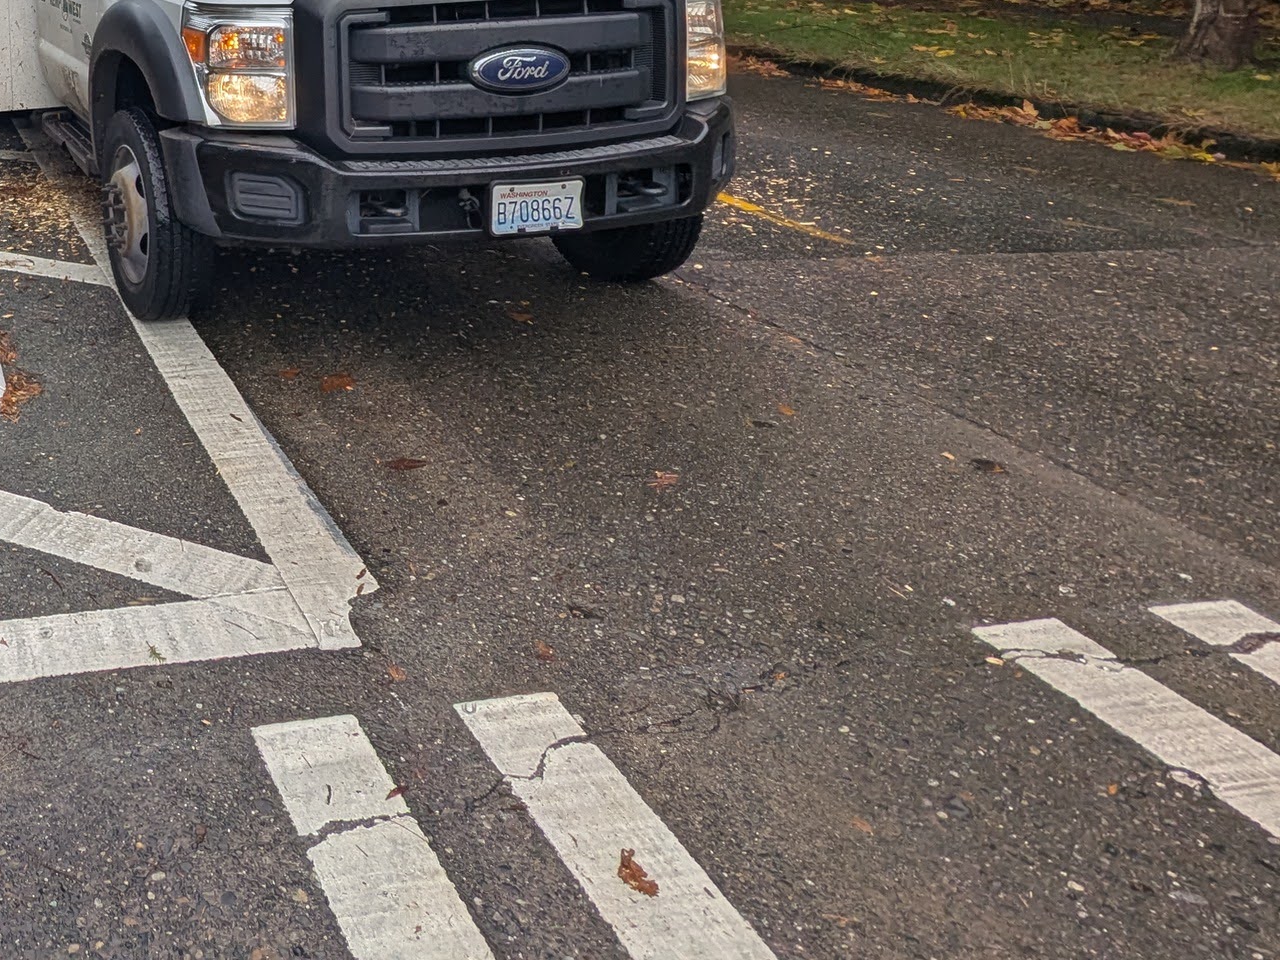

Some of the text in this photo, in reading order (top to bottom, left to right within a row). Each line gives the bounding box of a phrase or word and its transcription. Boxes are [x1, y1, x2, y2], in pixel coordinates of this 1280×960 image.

[497, 56, 550, 81] Ford
[500, 190, 549, 199] WASHINGTON
[497, 196, 575, 225] B70866Z
